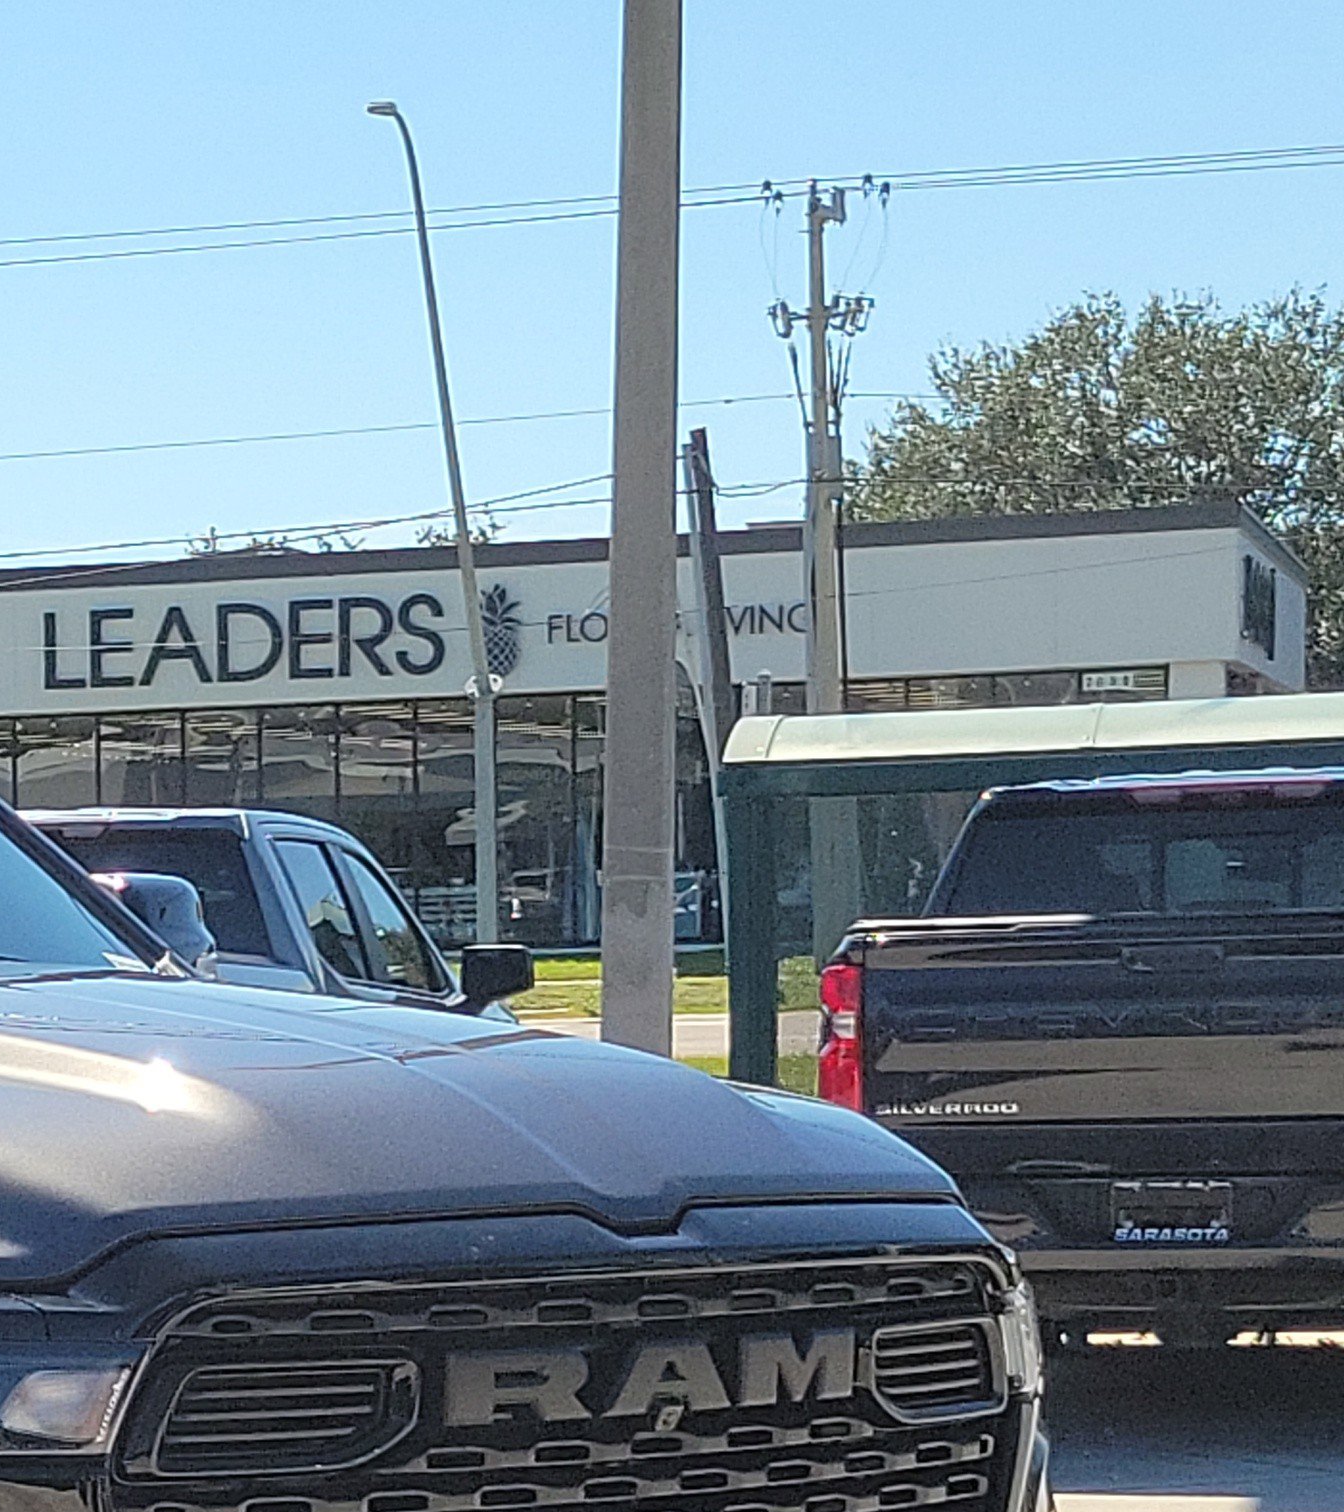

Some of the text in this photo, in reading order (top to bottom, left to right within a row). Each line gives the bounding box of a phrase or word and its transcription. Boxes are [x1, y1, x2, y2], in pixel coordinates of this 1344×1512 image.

[43, 593, 445, 690] LEADERS
[875, 1101, 1020, 1116] SILVERADO
[1114, 1228, 1229, 1241] SARASOTA
[442, 1327, 856, 1427] RAM
